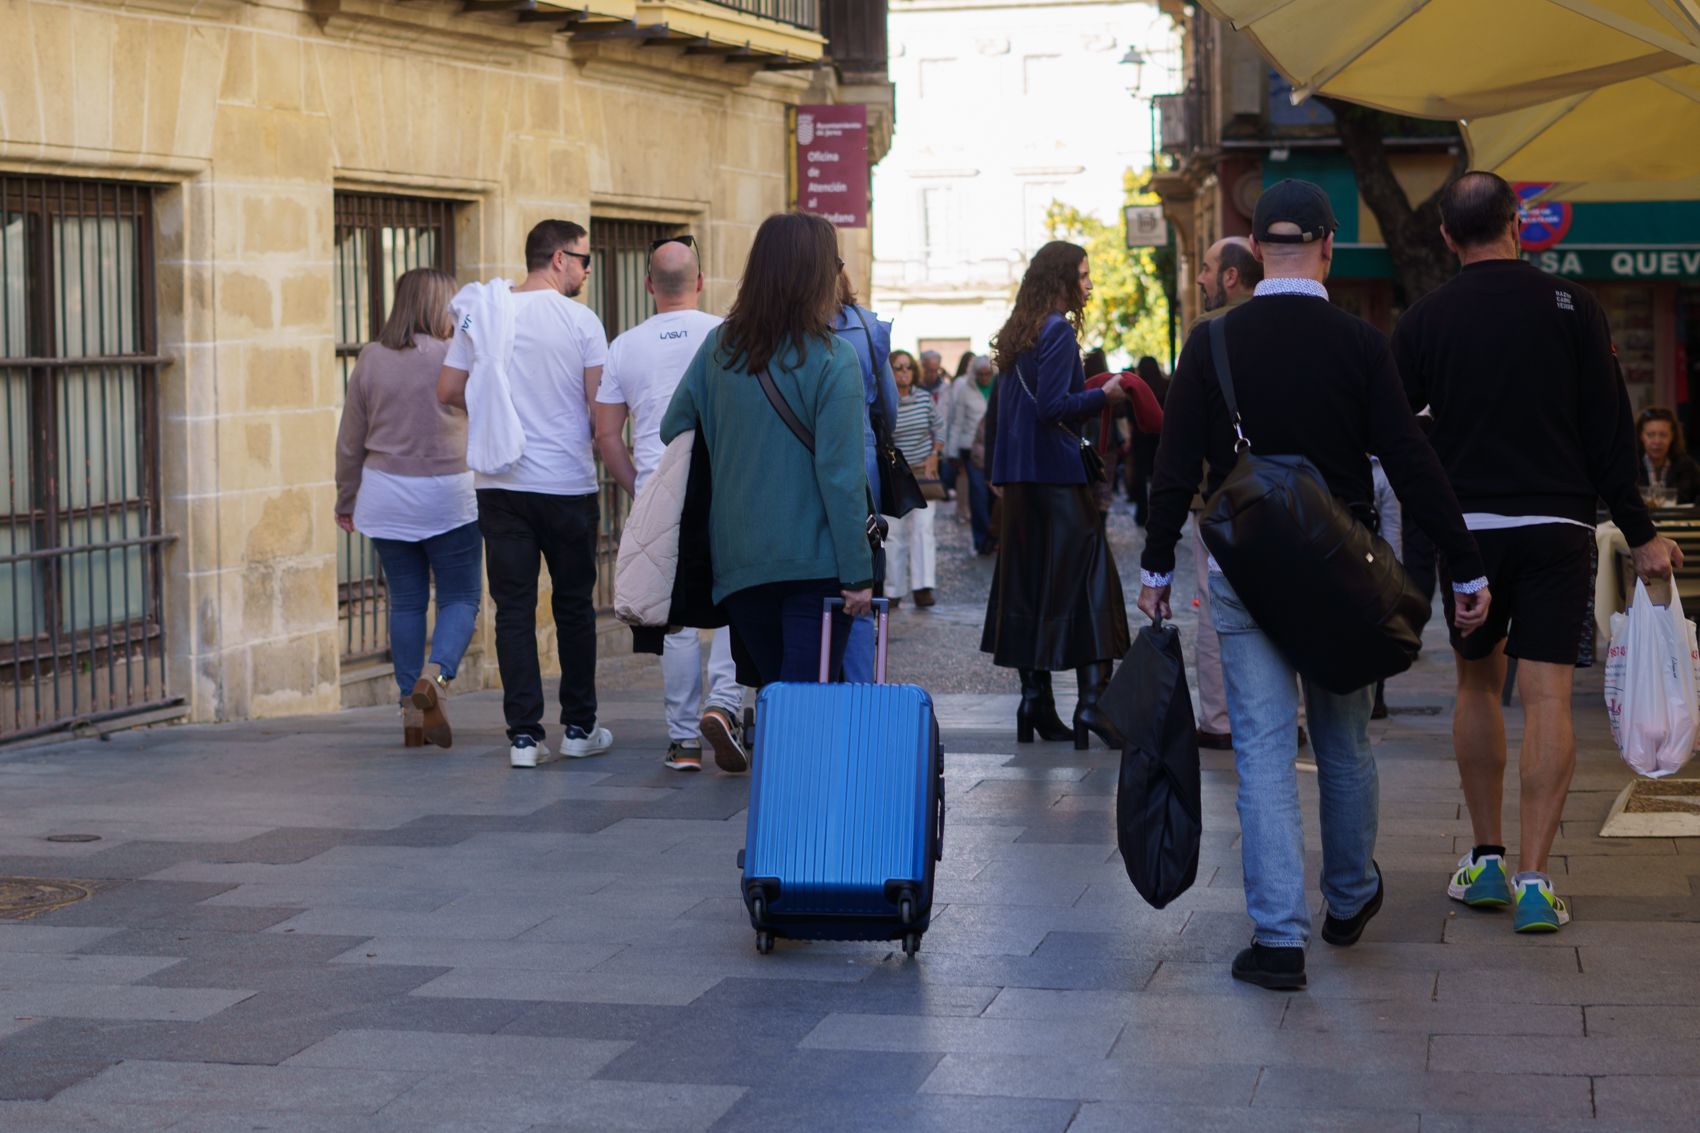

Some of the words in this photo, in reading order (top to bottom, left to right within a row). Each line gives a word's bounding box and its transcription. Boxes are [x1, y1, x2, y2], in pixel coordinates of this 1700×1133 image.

[807, 151, 839, 162] Oficina
[807, 167, 820, 178] de
[808, 182, 848, 193] Atención
[808, 197, 818, 208] al
